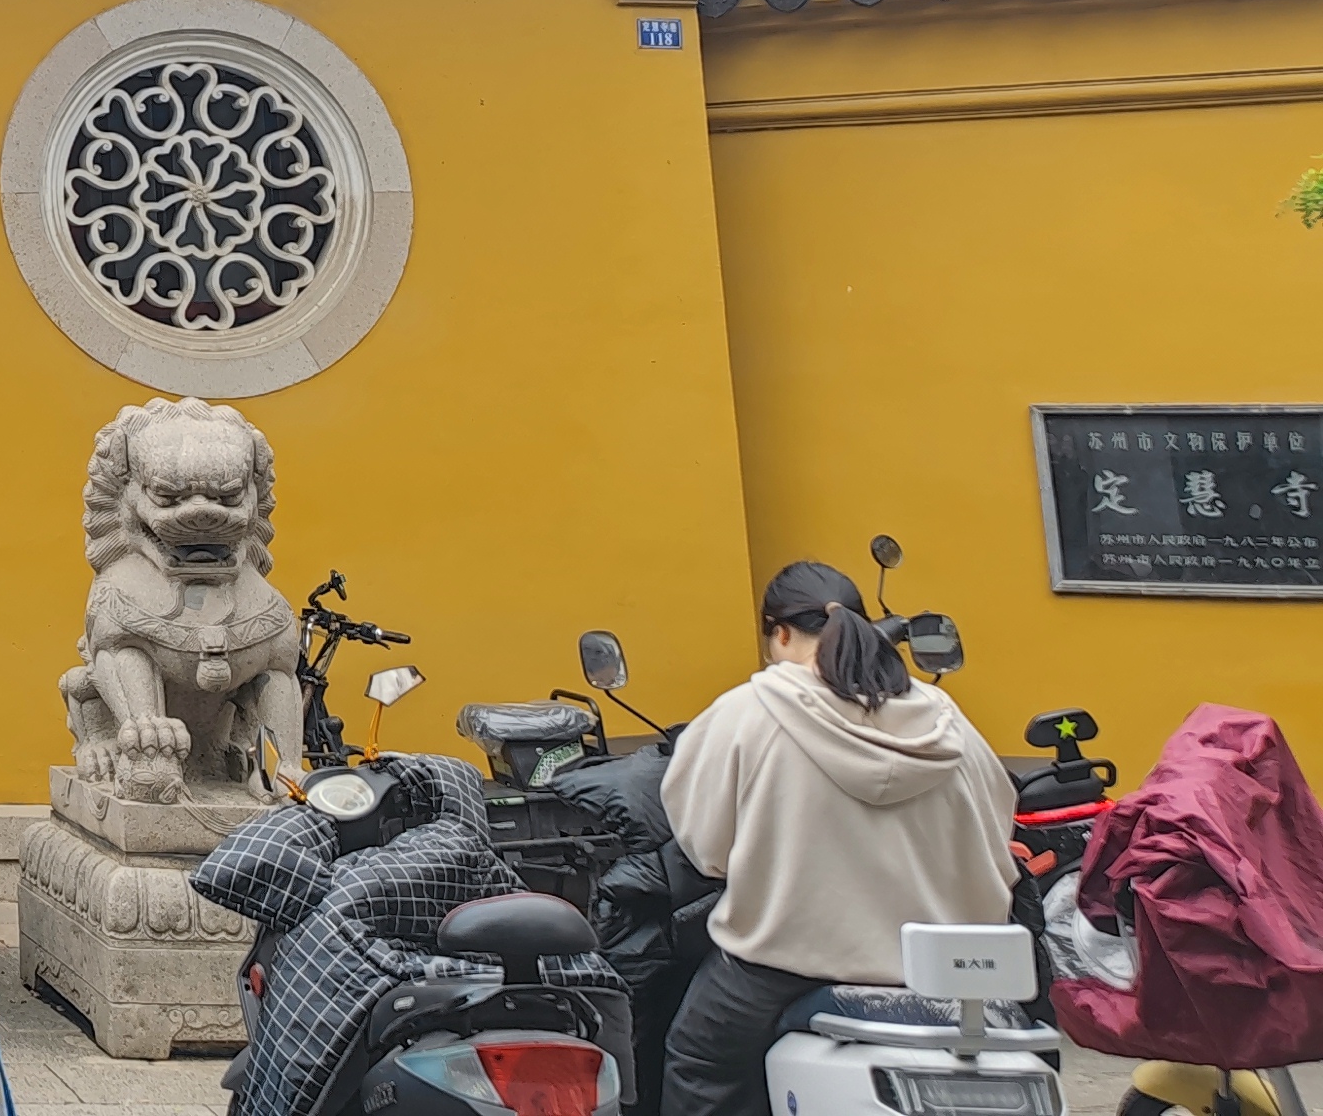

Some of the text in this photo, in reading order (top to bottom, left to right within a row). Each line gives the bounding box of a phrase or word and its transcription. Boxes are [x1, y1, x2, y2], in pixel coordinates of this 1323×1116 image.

[650, 33, 673, 46] 118
[1087, 431, 1306, 453] 苏州市文物保护单位
[1091, 469, 1319, 519] 定慧寺
[1099, 534, 1318, 548] 苏州市人民政府一九八二年公布
